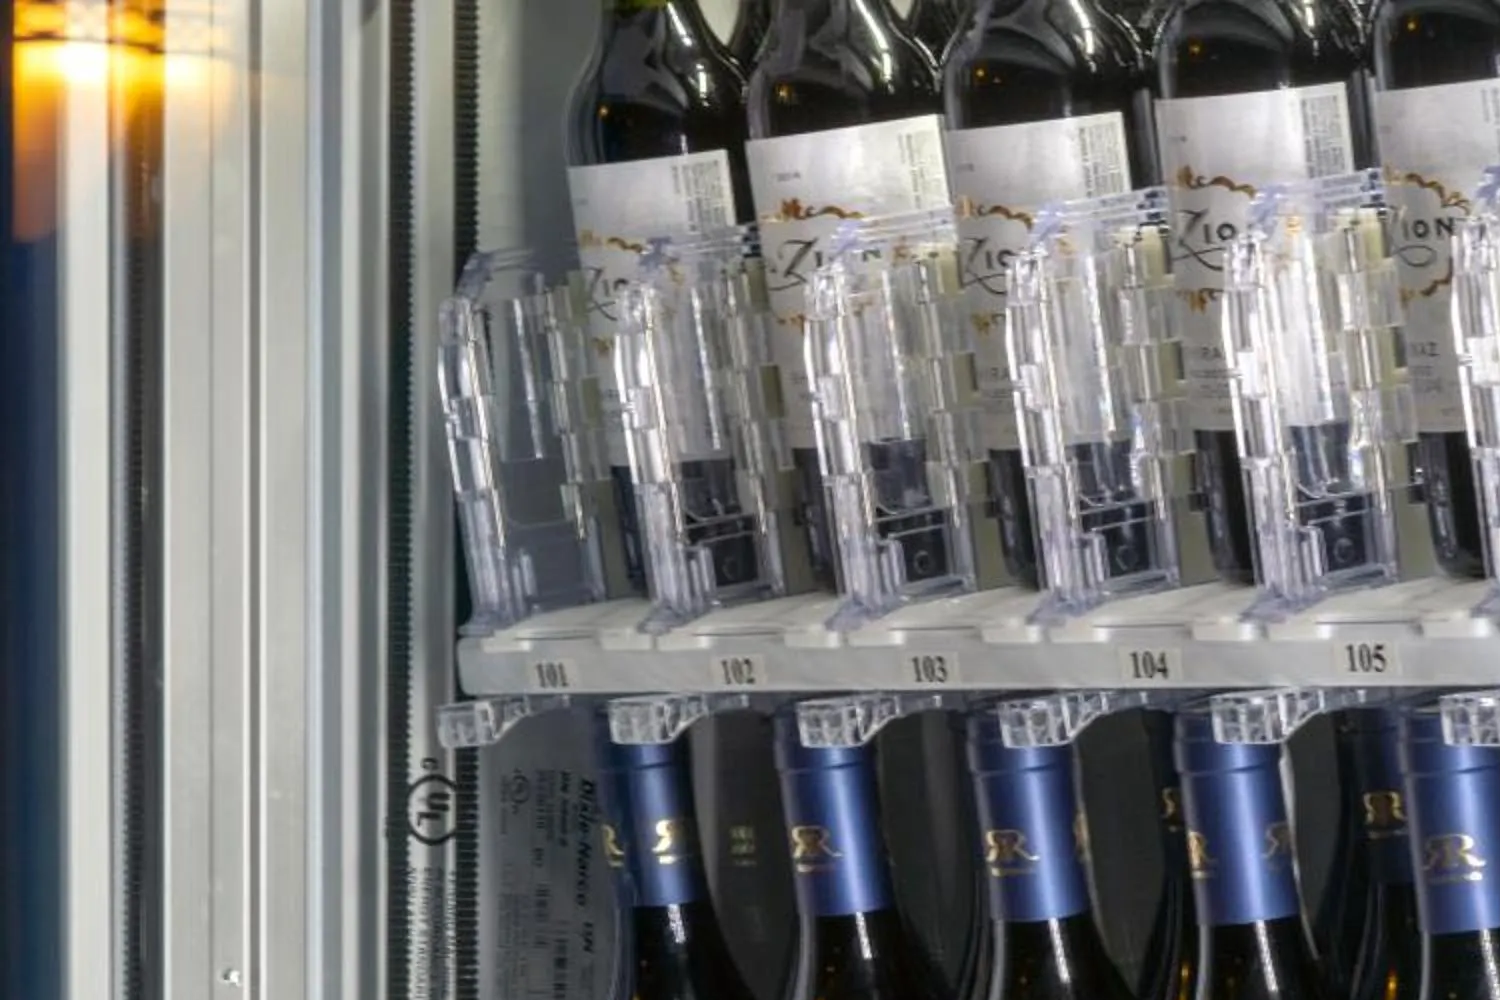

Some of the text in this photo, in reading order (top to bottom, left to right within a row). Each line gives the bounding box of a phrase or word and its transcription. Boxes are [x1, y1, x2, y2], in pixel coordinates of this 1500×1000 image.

[535, 662, 569, 690] 101
[721, 658, 755, 686] 102
[911, 654, 948, 683] 103
[1130, 651, 1169, 680] 104
[1346, 643, 1387, 674] 105
